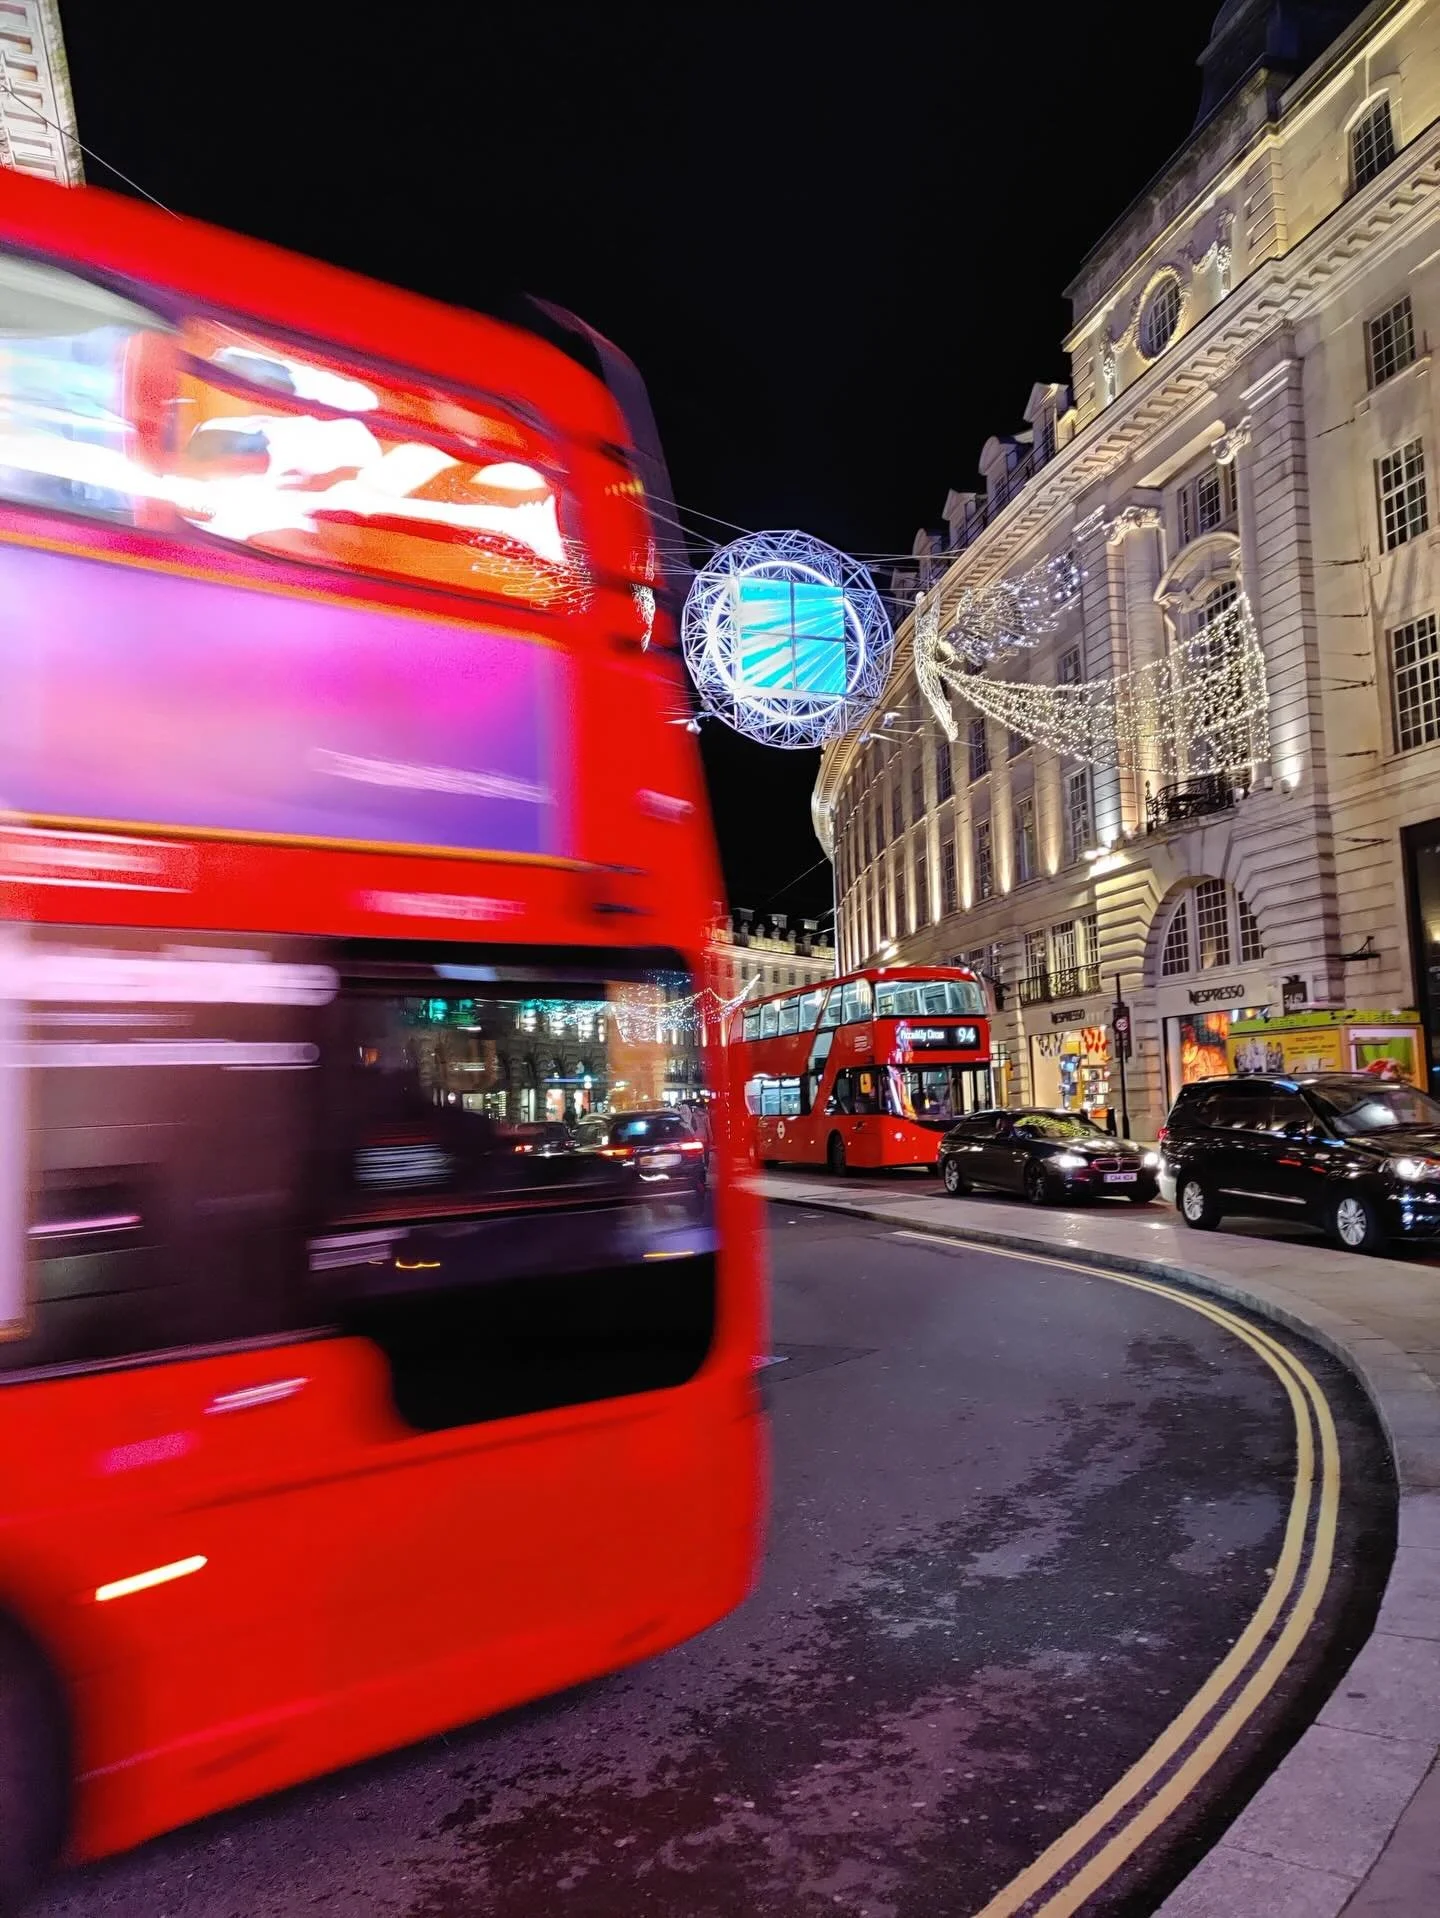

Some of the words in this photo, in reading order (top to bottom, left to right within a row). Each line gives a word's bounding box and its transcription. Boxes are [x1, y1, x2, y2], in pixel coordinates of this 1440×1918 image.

[1186, 984, 1245, 1006] NESPRESSO
[900, 1029, 926, 1042] Pcclly
[958, 1027, 976, 1042] 94
